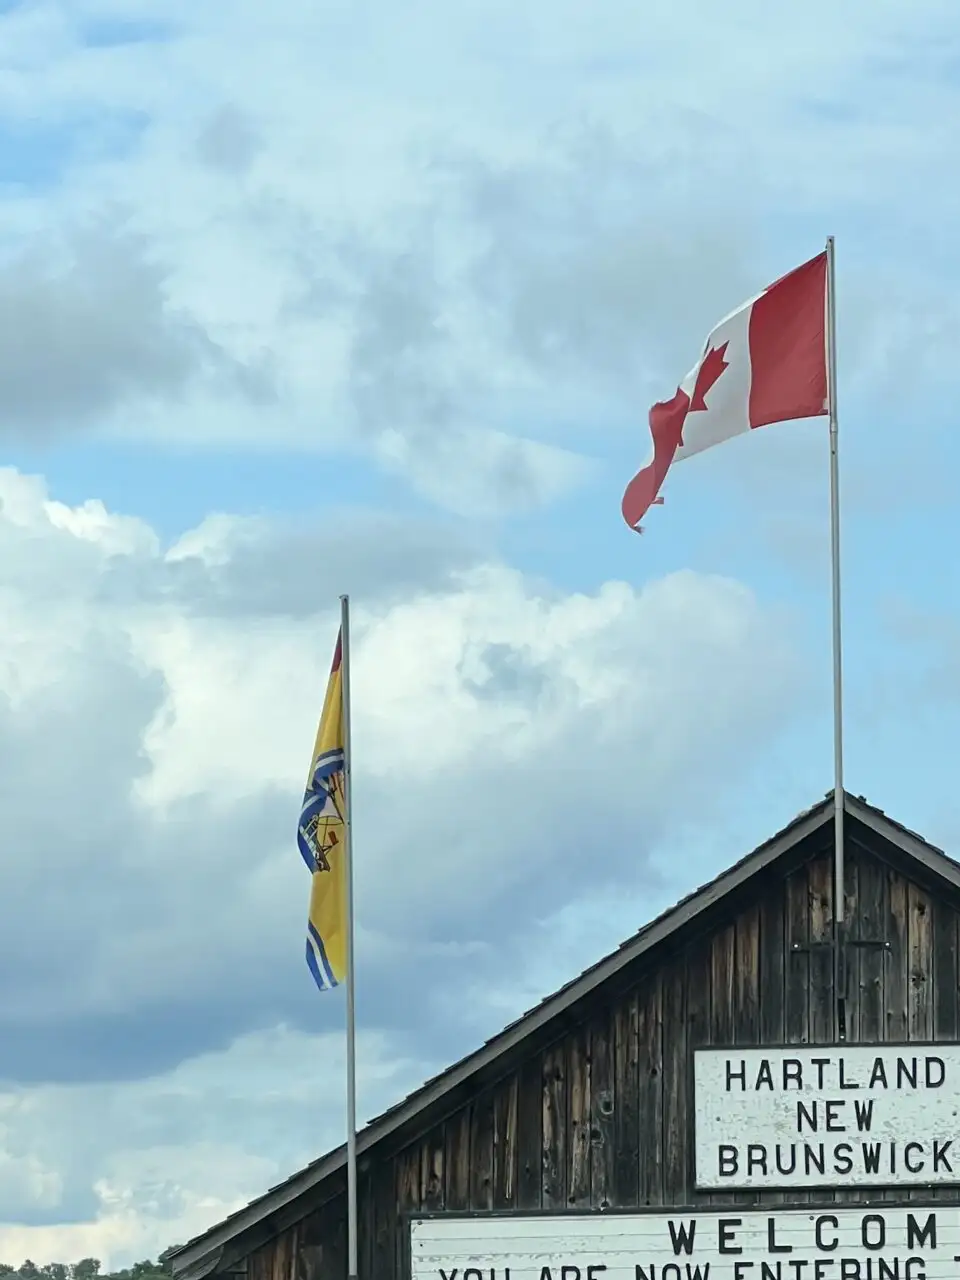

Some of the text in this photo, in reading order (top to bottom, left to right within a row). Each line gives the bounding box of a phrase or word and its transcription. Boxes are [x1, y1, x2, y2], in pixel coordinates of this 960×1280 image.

[726, 1057, 945, 1091] HARTLAND
[797, 1100, 873, 1132] NEW
[719, 1141, 952, 1176] BRUNSWICK
